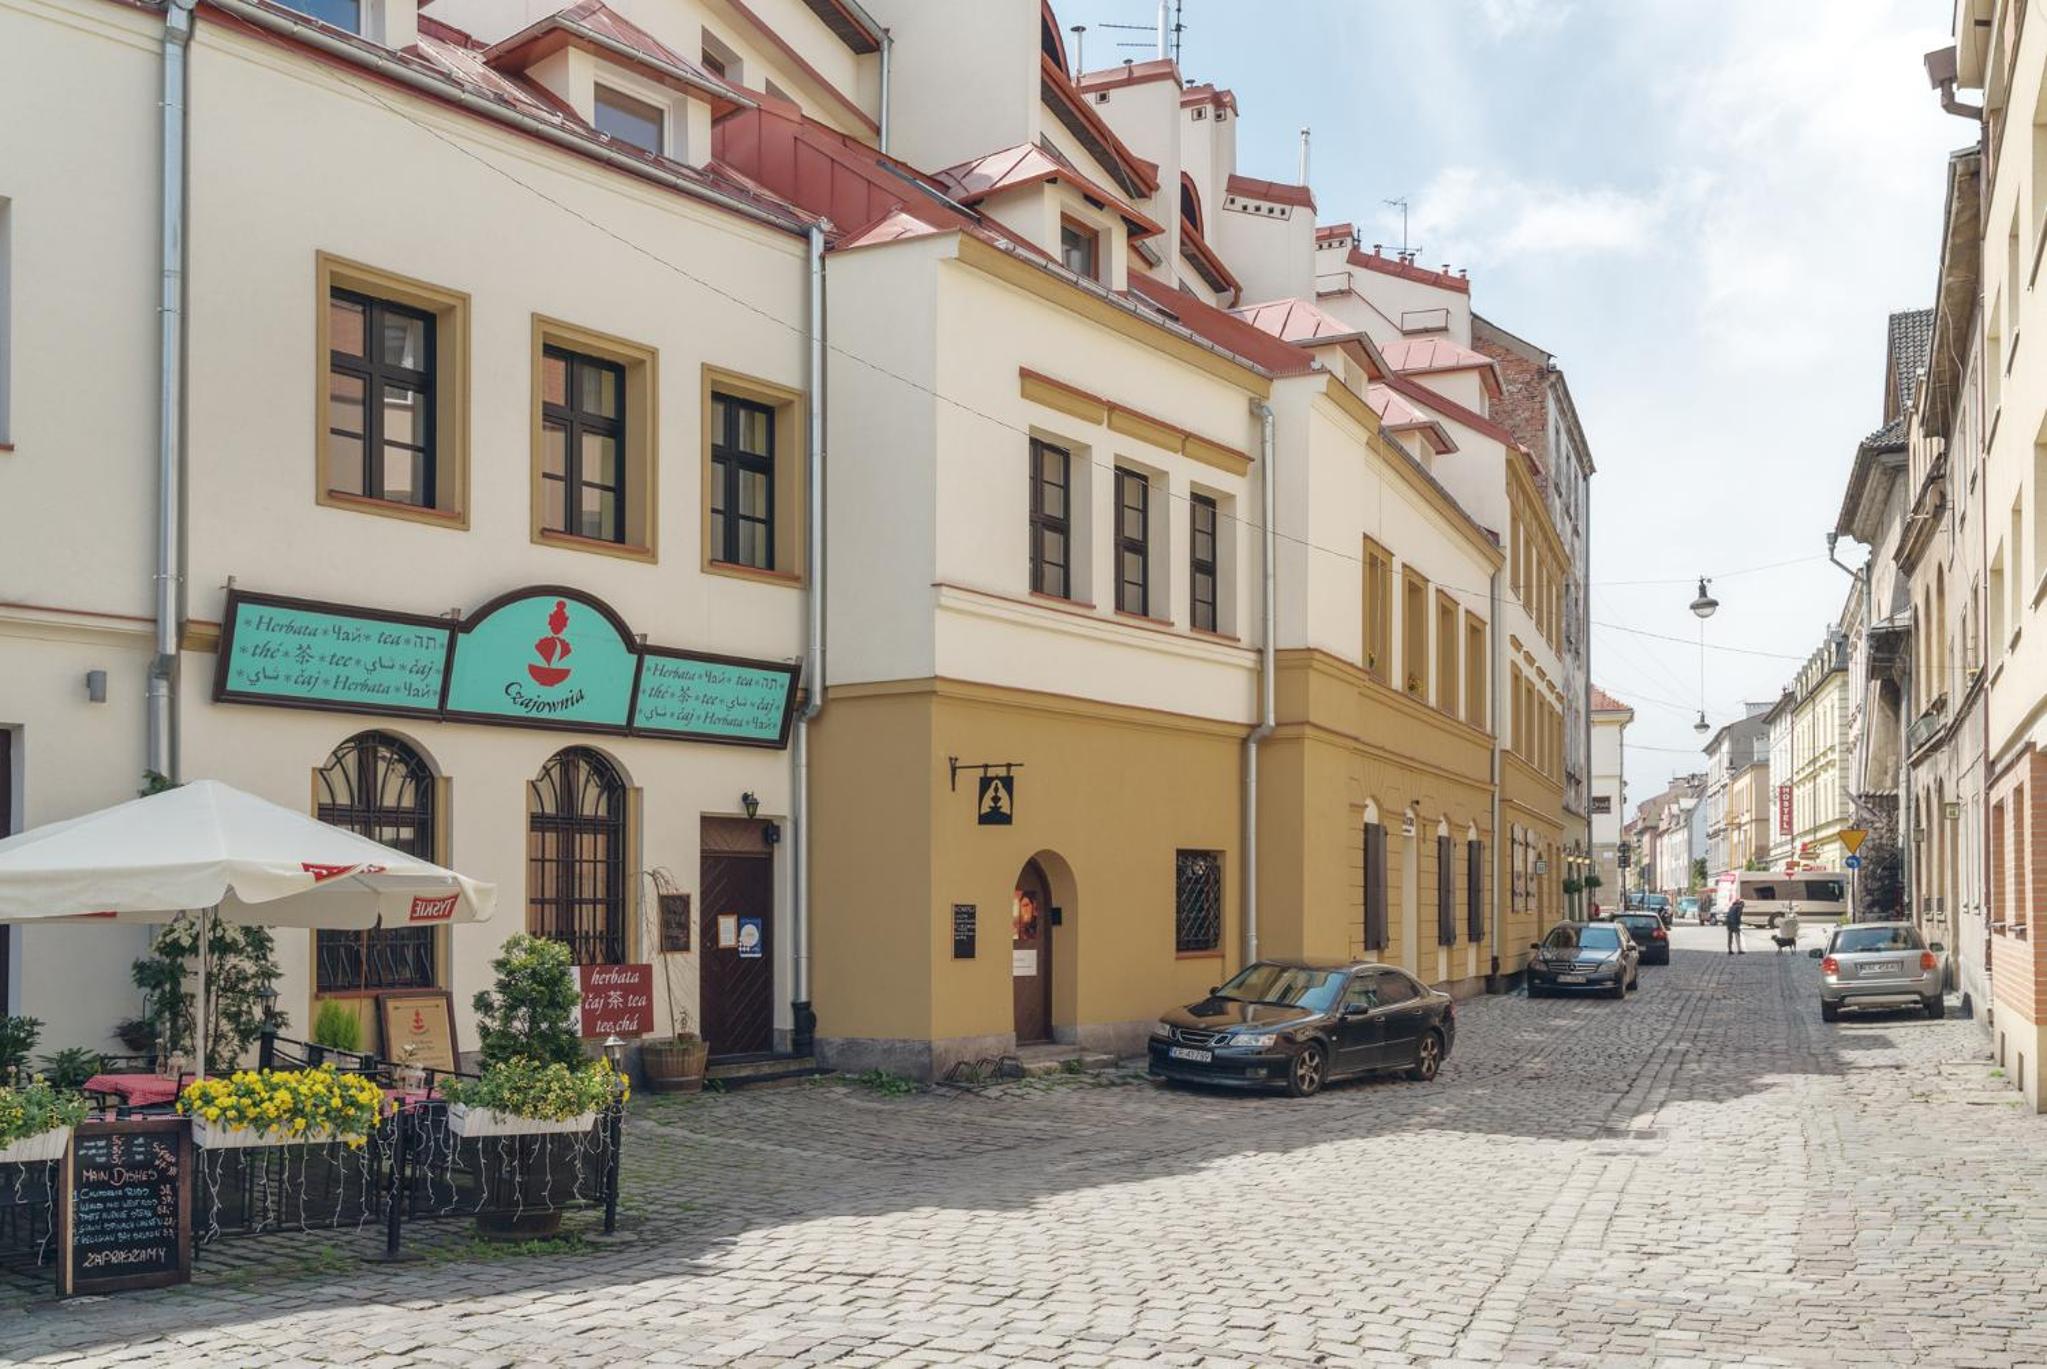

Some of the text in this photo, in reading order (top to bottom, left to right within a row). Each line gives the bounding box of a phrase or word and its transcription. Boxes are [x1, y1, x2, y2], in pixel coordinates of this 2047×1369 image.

[256, 615, 437, 650] Herbata Чай tea תה
[251, 640, 284, 659] thé
[295, 643, 314, 665] 茶
[294, 669, 321, 693] čaj
[332, 674, 391, 695] Herbata
[505, 682, 584, 713] Czajownia
[590, 967, 640, 986] herbata
[585, 990, 647, 1015] čaj 茶 tea
[616, 1013, 640, 1031] chá
[82, 1168, 109, 1183] MAIN
[83, 1247, 166, 1268] ZAPRASZAMY
